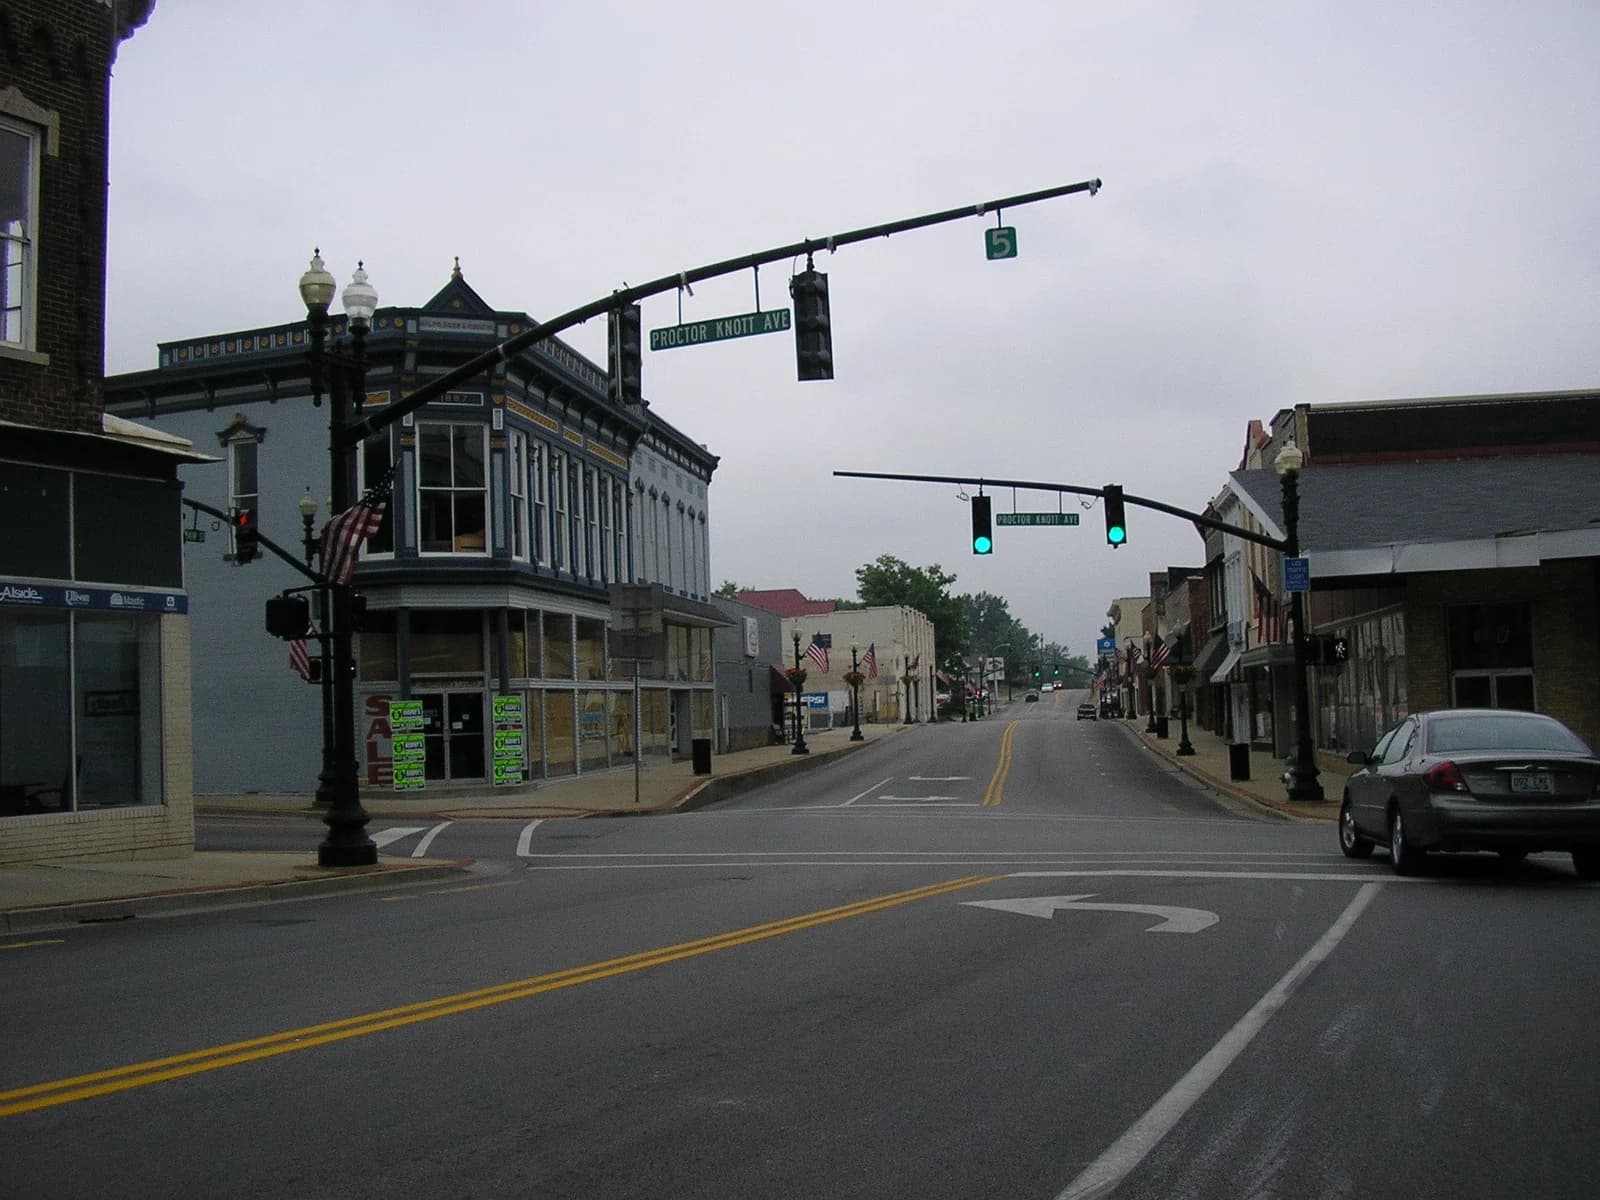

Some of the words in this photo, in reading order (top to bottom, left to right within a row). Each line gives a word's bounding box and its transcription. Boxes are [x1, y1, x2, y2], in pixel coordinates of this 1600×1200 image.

[992, 228, 1011, 257] 5
[652, 325, 707, 348] PROCTOR
[715, 316, 754, 338] KNOTT
[763, 310, 789, 330] AVE
[997, 515, 1032, 525] PROCTOR
[1036, 515, 1059, 525] KNOTT
[1063, 515, 1079, 525] AVE
[1, 586, 40, 600] Alside
[366, 695, 393, 786] SALE
